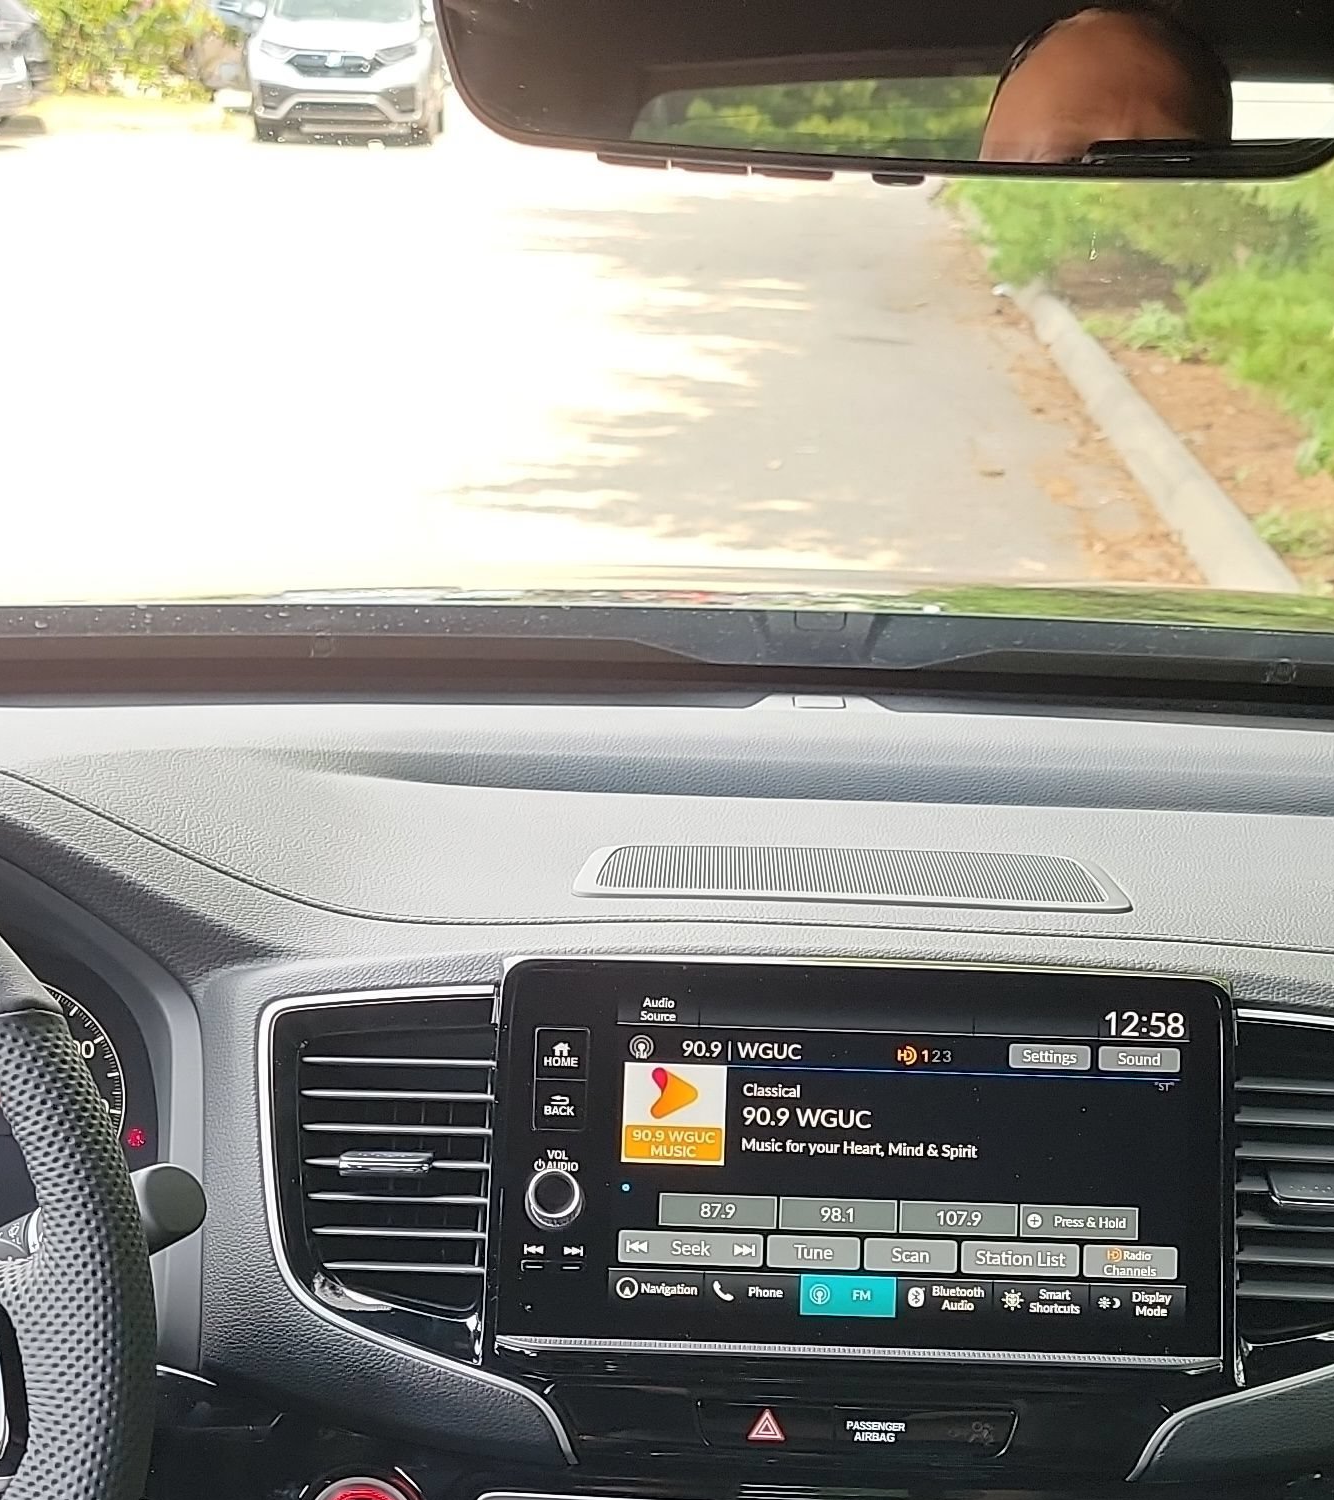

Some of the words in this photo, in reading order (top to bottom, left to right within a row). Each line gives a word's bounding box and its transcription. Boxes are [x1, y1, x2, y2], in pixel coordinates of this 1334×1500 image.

[643, 997, 675, 1009] Audio
[640, 1011, 677, 1022] Source
[1104, 1010, 1185, 1038] 12:58
[682, 1040, 722, 1058] 90.9
[737, 1042, 802, 1060] WGUC
[543, 1056, 579, 1068] HOME
[1022, 1050, 1078, 1065] Settings
[1117, 1053, 1161, 1067] Sound
[742, 1083, 801, 1099] Classical
[543, 1105, 575, 1116] BACK
[742, 1106, 790, 1126] 90.9
[796, 1107, 873, 1129] WGUC
[632, 1129, 665, 1142] 90.9
[668, 1131, 716, 1144] WGUC
[547, 1149, 569, 1160] VOL
[650, 1145, 697, 1158] MUSIC
[741, 1138, 783, 1153] Music
[785, 1138, 806, 1153] for
[807, 1142, 840, 1156] your
[843, 1141, 885, 1159] Heart,
[888, 1143, 923, 1157] Mind
[927, 1144, 939, 1157] &
[941, 1144, 978, 1161] Spirit
[546, 1161, 579, 1172] AUDIO
[700, 1203, 736, 1219] 87.9
[820, 1206, 855, 1223] 98.1
[936, 1210, 983, 1227] 107.9
[1053, 1215, 1084, 1228] Press
[1086, 1216, 1097, 1228] &
[1098, 1217, 1127, 1230] Hold
[671, 1239, 711, 1257] Seek
[793, 1244, 834, 1261] Tune
[891, 1247, 930, 1264] Scan
[975, 1250, 1034, 1267] Station
[1037, 1252, 1066, 1268] List
[1123, 1250, 1152, 1261] Radio
[1103, 1264, 1157, 1277] Channels
[640, 1283, 698, 1297] Navigation
[747, 1285, 784, 1299] Phone
[852, 1289, 871, 1302] FM
[932, 1285, 985, 1299] Bluetooth
[1039, 1288, 1071, 1301] Smart
[941, 1299, 975, 1312] Audio
[1131, 1291, 1172, 1306] Display
[1029, 1302, 1081, 1316] Shortcuts
[1135, 1304, 1168, 1317] Mode
[846, 1420, 906, 1433] PASSENGER
[853, 1432, 896, 1443] AIRBAG
